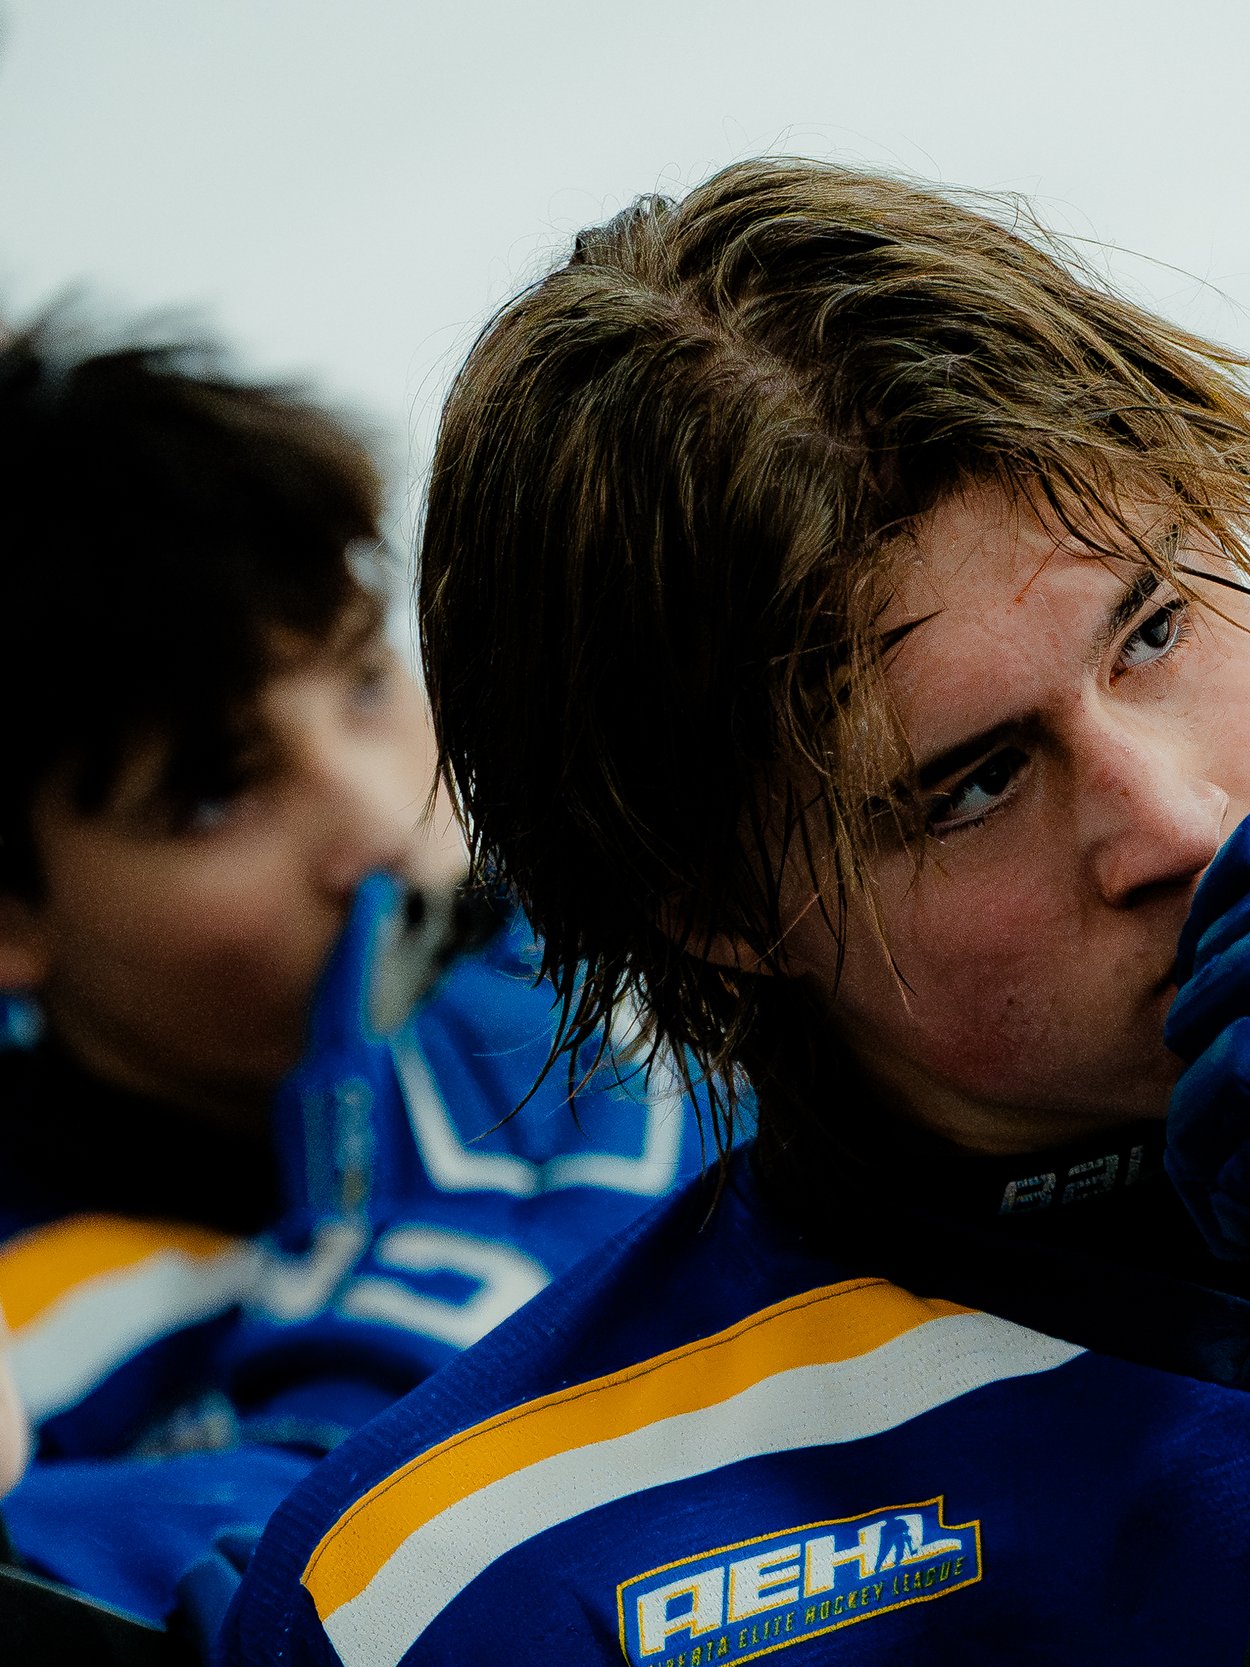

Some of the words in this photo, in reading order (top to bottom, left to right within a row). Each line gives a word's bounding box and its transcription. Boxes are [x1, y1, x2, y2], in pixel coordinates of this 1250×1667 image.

[637, 1513, 962, 1660] AEHL
[738, 1610, 796, 1649] ELITE
[804, 1580, 884, 1627] HOCKEY
[892, 1554, 967, 1598] LEAGUE
